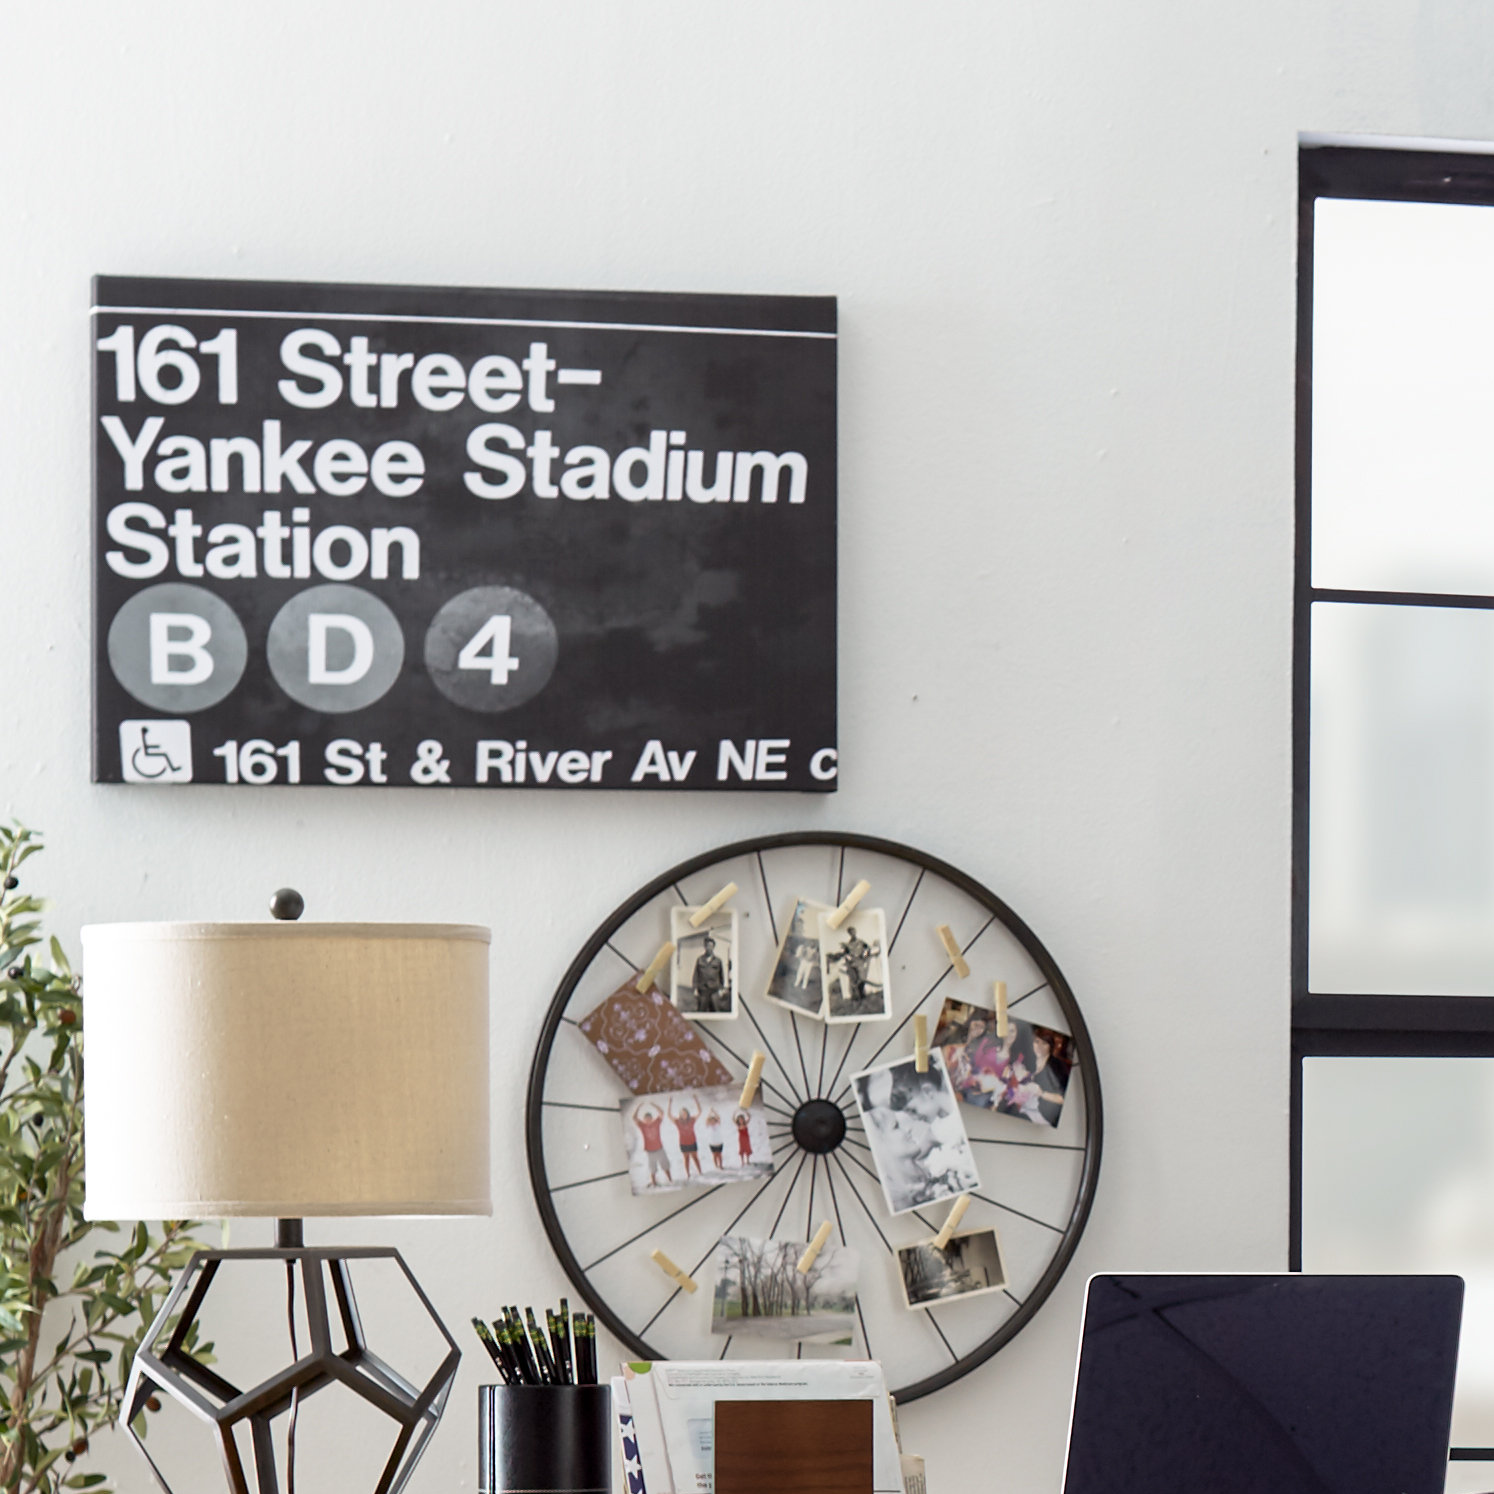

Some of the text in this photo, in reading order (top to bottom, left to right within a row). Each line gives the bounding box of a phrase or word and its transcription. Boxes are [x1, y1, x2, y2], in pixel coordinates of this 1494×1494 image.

[96, 324, 238, 405] 161
[101, 415, 809, 503] Yankee Stadium
[105, 502, 420, 581] Station
[149, 612, 520, 686] B D 4
[213, 739, 300, 784] 161
[324, 739, 387, 784] St
[410, 740, 451, 784] &
[476, 740, 613, 783] River
[631, 740, 696, 782] Av
[717, 739, 790, 781] NE
